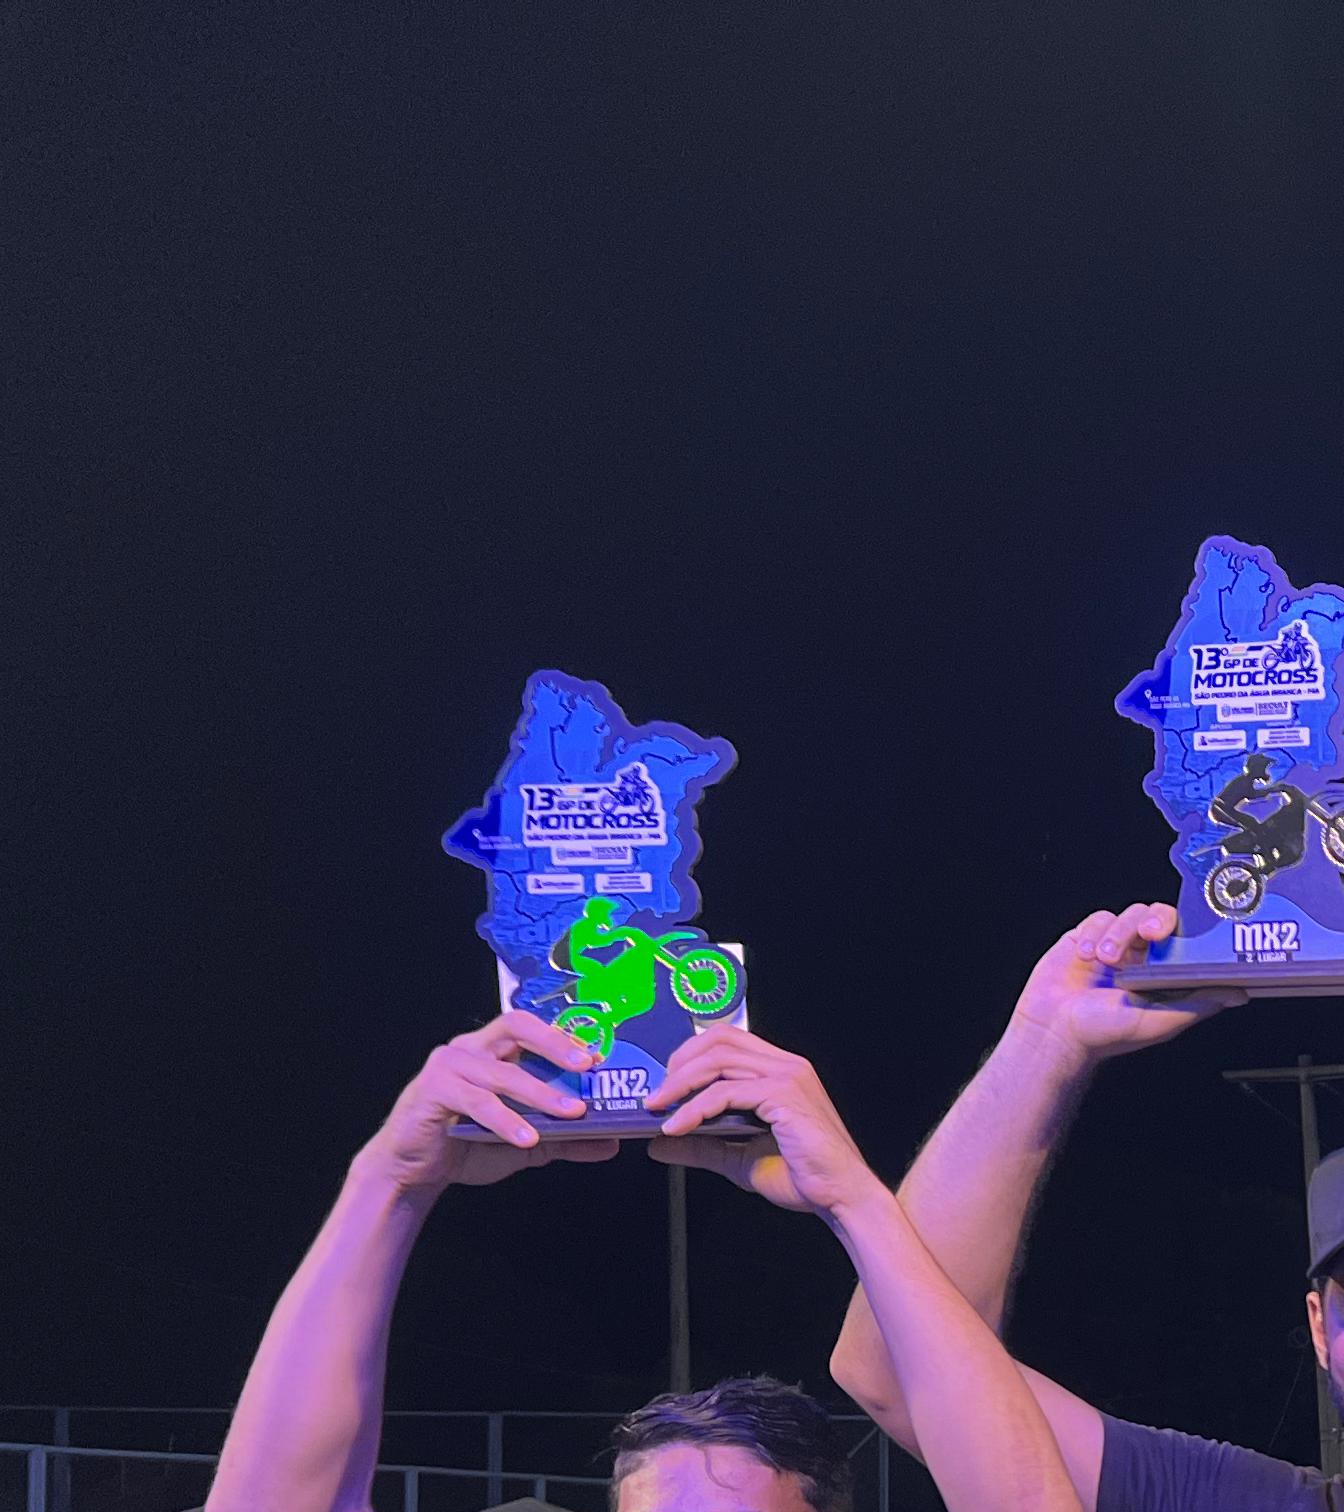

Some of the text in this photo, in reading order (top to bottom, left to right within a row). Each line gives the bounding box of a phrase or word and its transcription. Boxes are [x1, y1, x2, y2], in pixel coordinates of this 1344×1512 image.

[1243, 658, 1260, 668] DE
[1194, 668, 1318, 689] MOTOCROSS
[526, 813, 660, 830] MOTOCROSS
[1234, 922, 1298, 951] MX2
[582, 1068, 650, 1100] MX2
[606, 1100, 638, 1110] LUGAR
